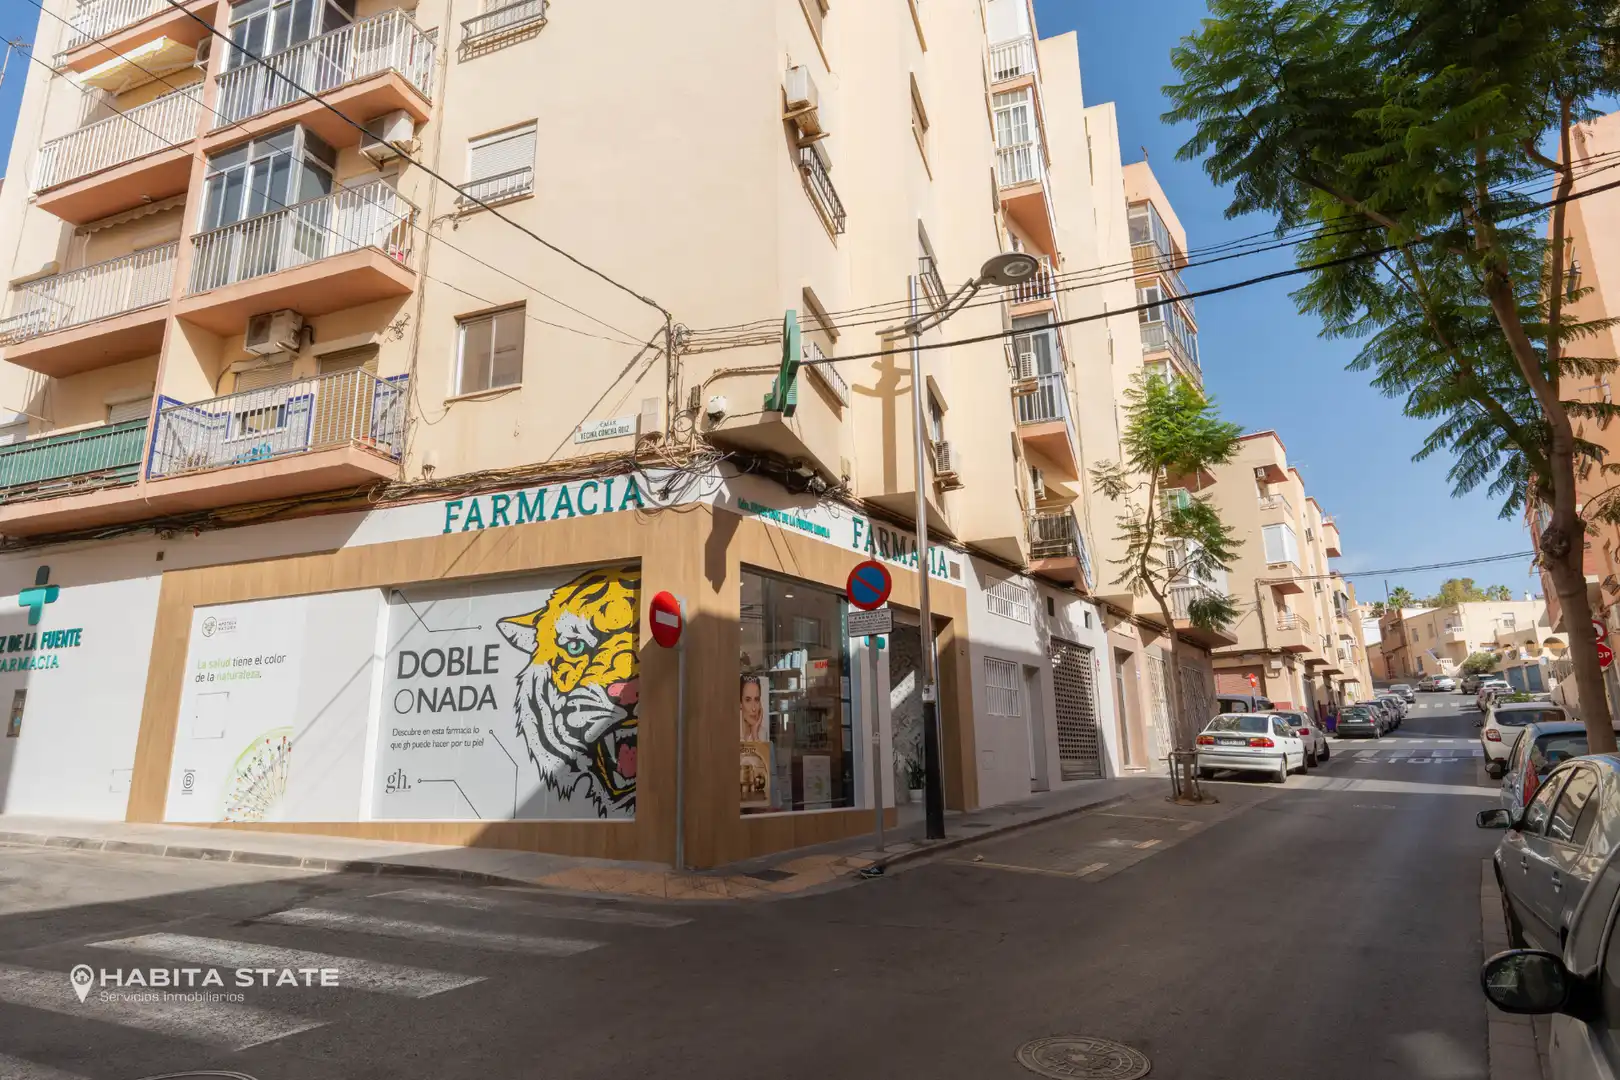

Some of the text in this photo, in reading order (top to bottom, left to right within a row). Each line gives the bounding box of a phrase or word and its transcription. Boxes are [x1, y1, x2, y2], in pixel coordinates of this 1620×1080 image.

[443, 474, 645, 534] FARMACIA
[852, 516, 948, 579] FARMAIA
[7, 634, 23, 652] DE
[23, 633, 37, 651] LA
[40, 628, 83, 650] FUENTE
[0, 654, 59, 673] ARMACIA
[197, 653, 286, 669] La salud tiene el color
[397, 643, 500, 679] DOBLE
[195, 669, 262, 683] de la naturaleza.
[392, 728, 421, 736] Descubre
[431, 727, 444, 735] esta
[446, 726, 471, 735] farmacia
[473, 726, 480, 734] lo
[390, 742, 402, 750] que
[403, 740, 411, 750] gh
[412, 740, 431, 750] puede
[432, 740, 450, 748] hacer
[450, 740, 463, 748] por
[472, 738, 484, 748] piel
